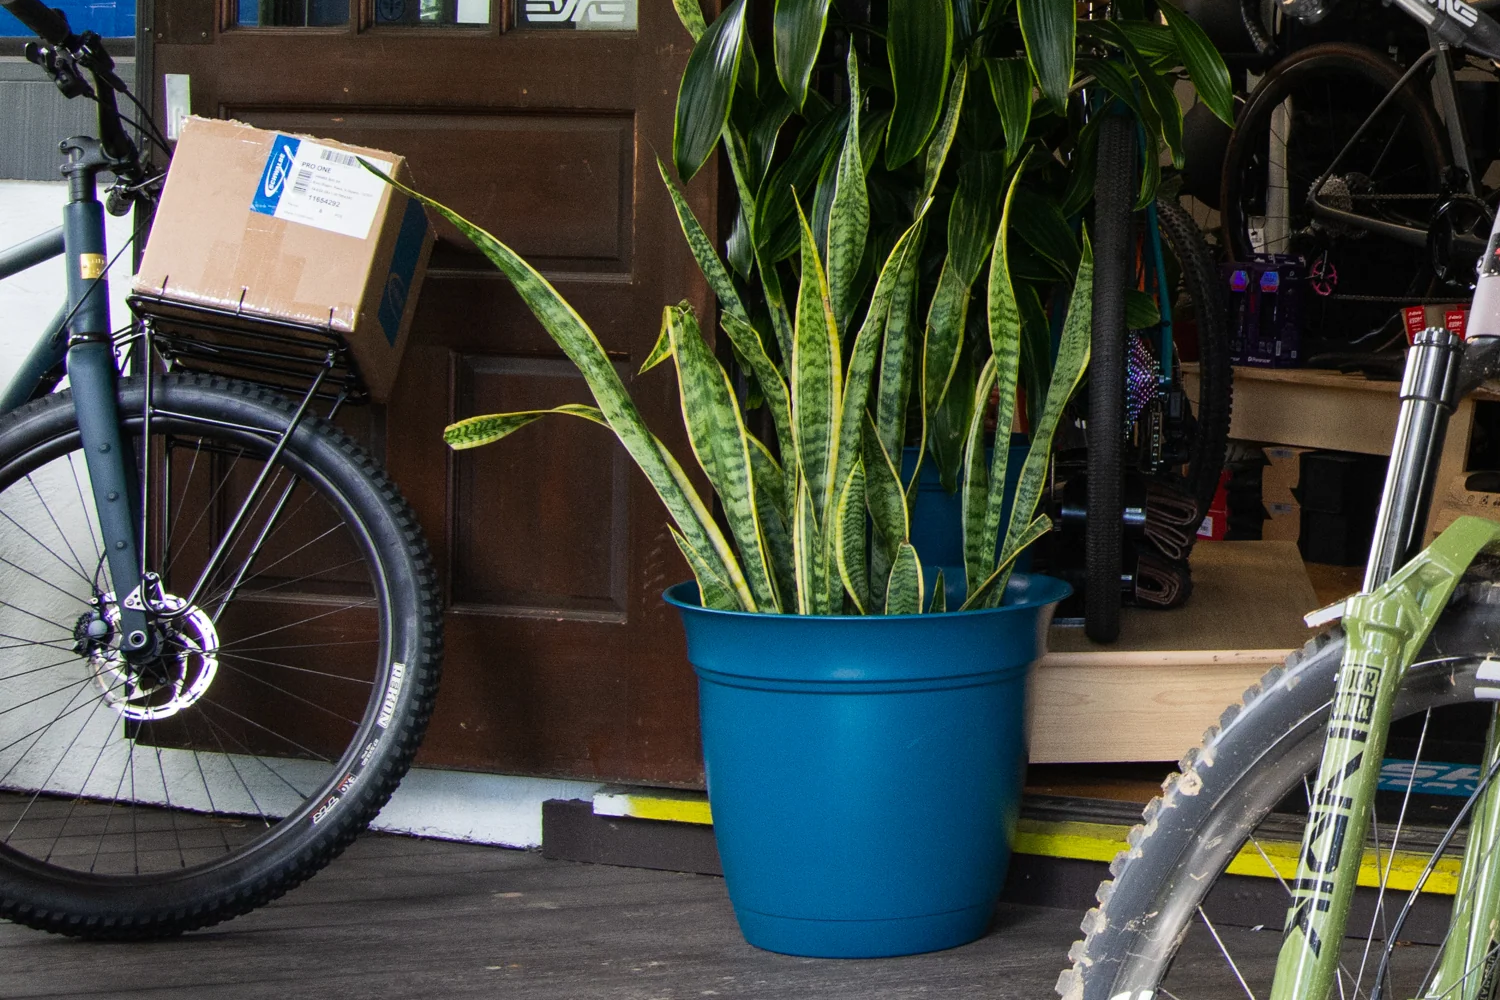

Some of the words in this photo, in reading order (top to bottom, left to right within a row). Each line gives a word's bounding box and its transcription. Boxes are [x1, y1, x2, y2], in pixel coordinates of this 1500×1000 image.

[268, 153, 286, 191] SCHWALBE
[301, 161, 316, 171] PRO
[317, 164, 332, 174] ONE
[376, 661, 406, 729] REKON
